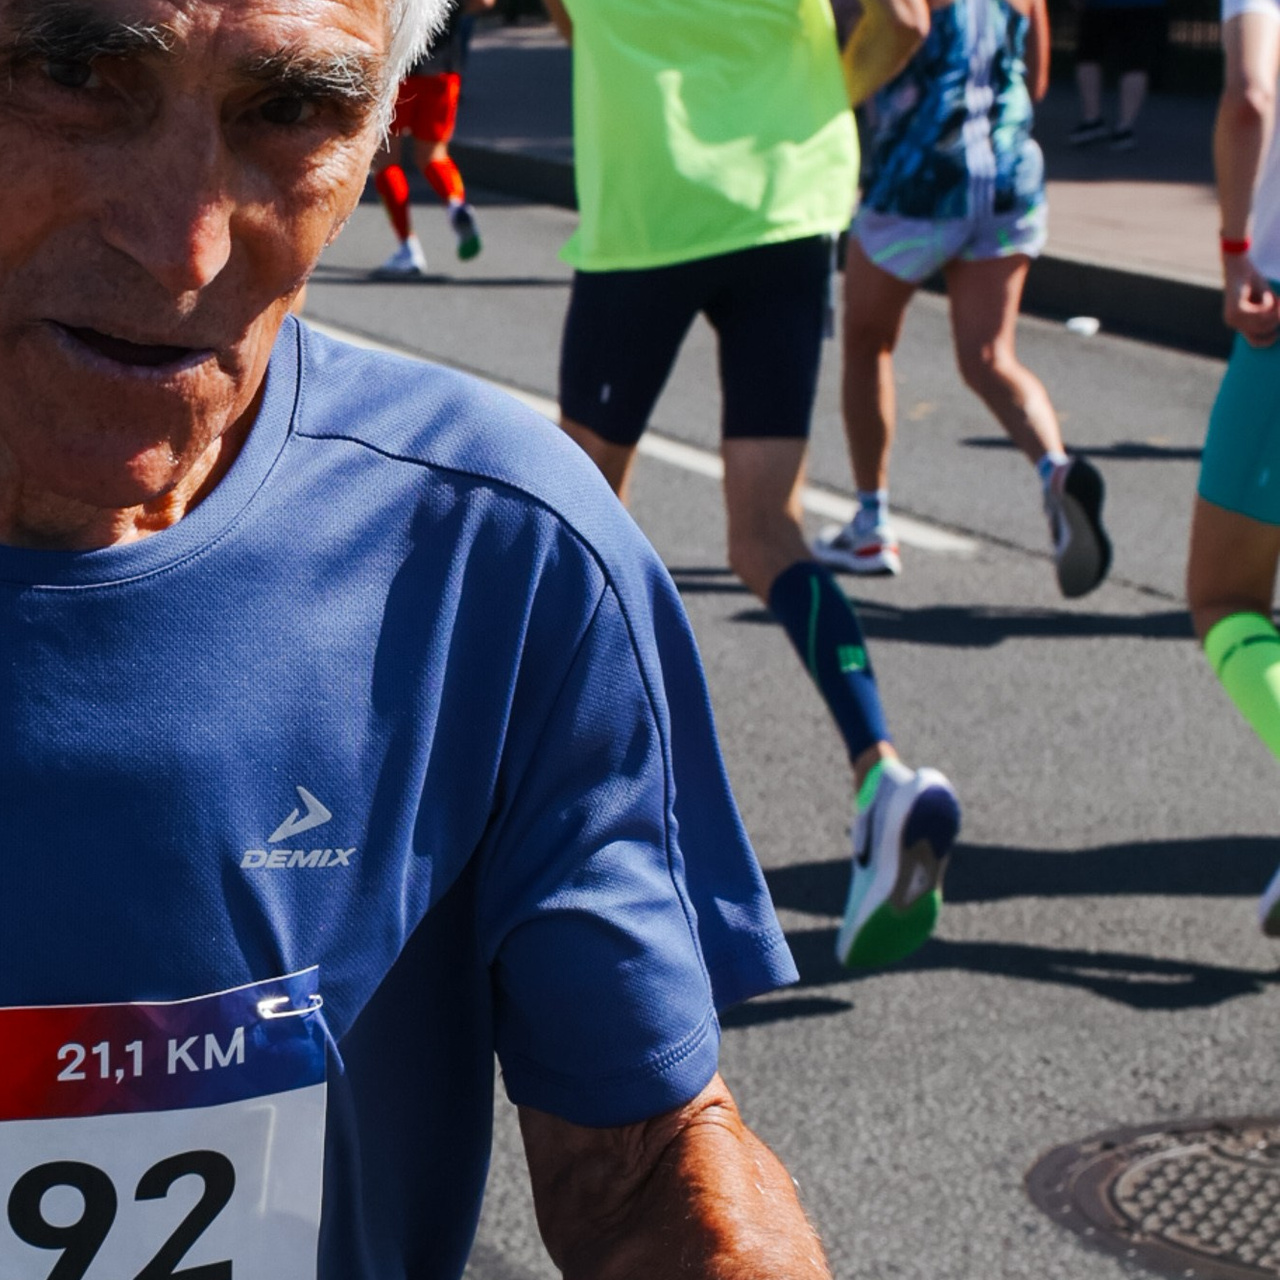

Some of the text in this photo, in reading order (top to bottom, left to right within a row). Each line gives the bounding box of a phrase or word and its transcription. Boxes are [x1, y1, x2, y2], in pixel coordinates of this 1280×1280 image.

[240, 847, 357, 868] DEMIX
[56, 1025, 246, 1085] 21,1 КМ
